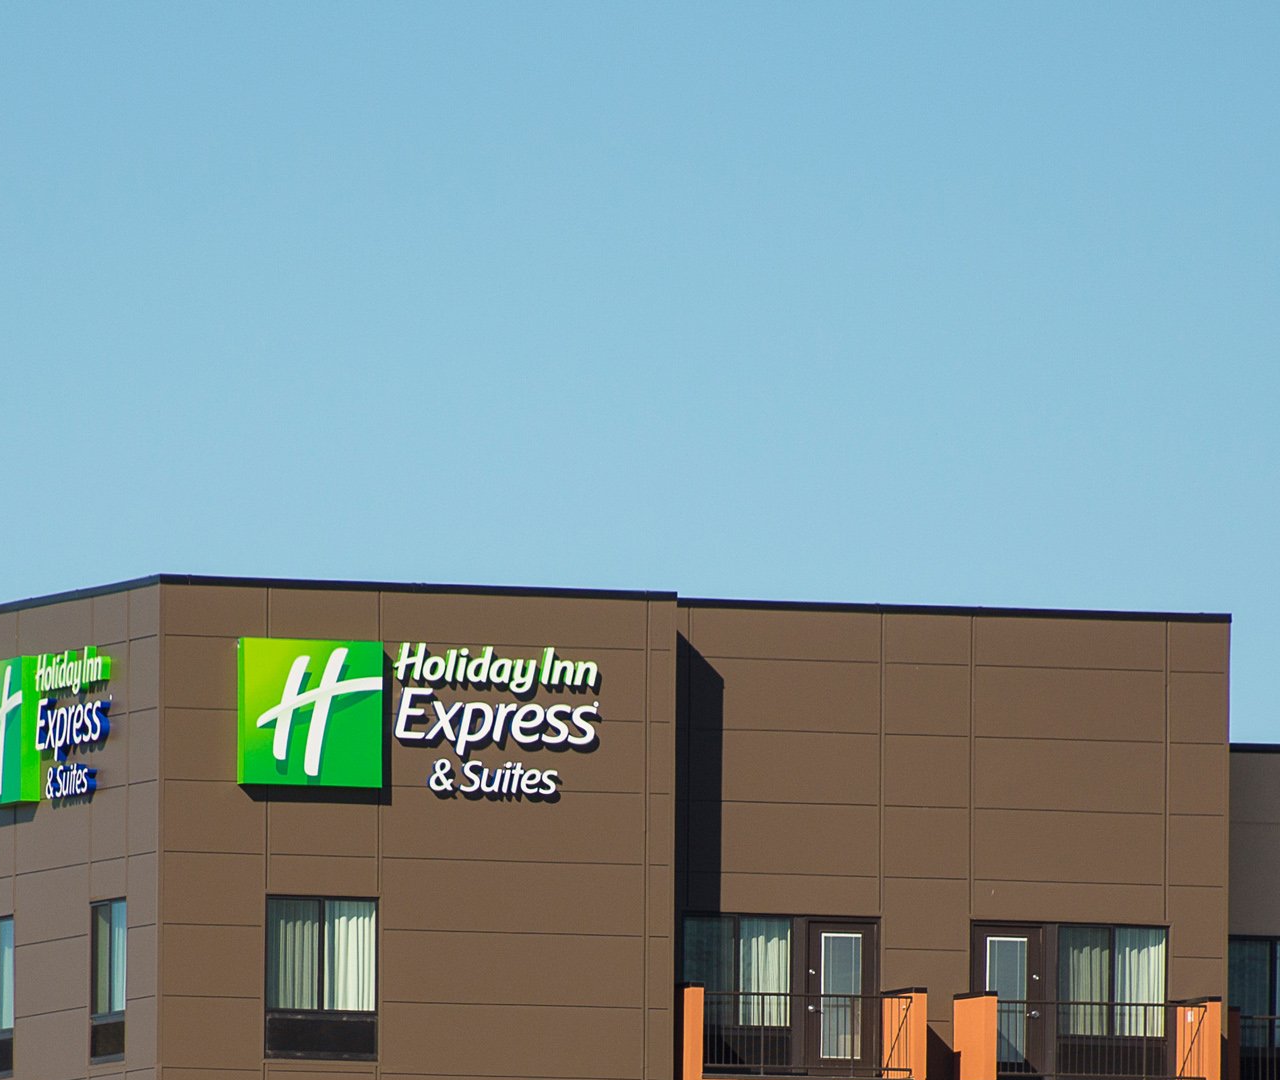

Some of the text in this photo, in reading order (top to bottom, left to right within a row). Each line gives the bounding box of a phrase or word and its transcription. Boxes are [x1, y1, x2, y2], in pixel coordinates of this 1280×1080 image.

[35, 646, 102, 695] Holiday Inn
[393, 642, 598, 693] Holiday Inn
[35, 698, 101, 761] Express
[394, 687, 598, 756] Express
[46, 763, 88, 799] & Suites
[428, 759, 559, 795] & Suites
